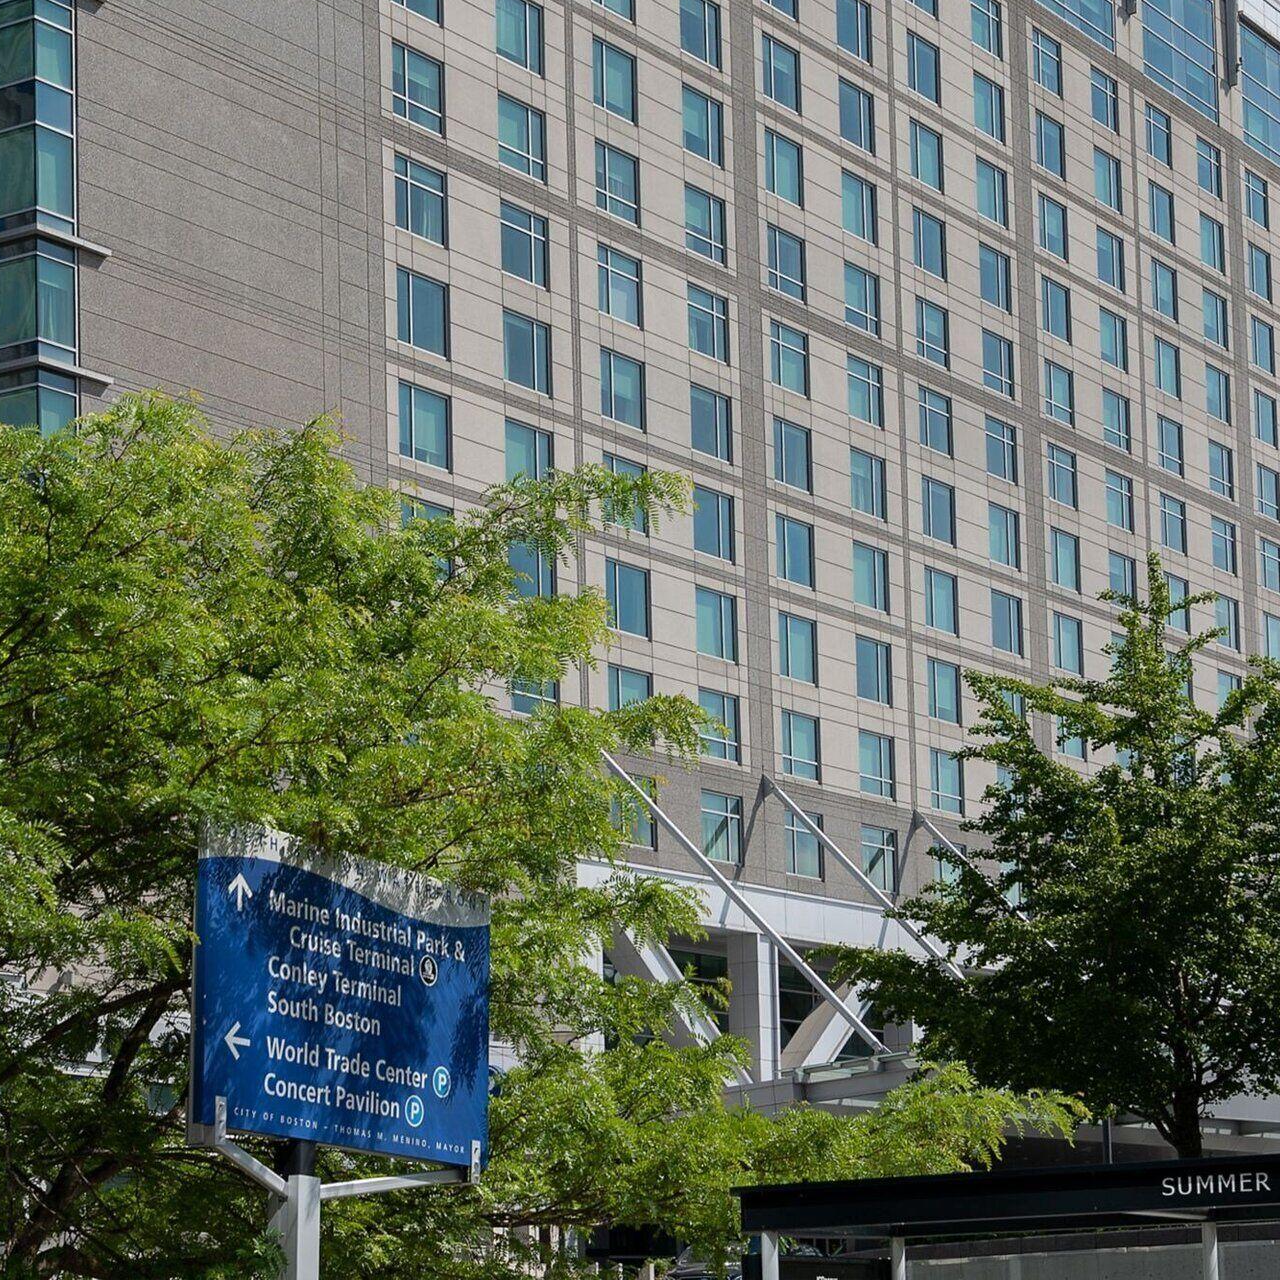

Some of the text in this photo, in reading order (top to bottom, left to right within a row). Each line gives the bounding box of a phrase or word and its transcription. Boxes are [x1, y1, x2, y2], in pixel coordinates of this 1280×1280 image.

[269, 889, 465, 962] Marine Industrial Park &
[290, 925, 414, 976] Cruise Terminal
[268, 956, 401, 1007] Conley Terminal
[268, 990, 380, 1036] South Boston
[267, 1036, 319, 1067] World
[324, 1047, 370, 1078] Trade
[376, 1060, 428, 1089] Center
[264, 1072, 331, 1106] Concert
[336, 1085, 400, 1119] Pavilion
[233, 1106, 257, 1119] CITY
[263, 1112, 274, 1121] OF
[280, 1114, 318, 1130] BOSTON
[334, 1124, 371, 1138] THOMAS
[377, 1132, 387, 1141] M.
[436, 1141, 465, 1154] MAYOR
[1161, 1171, 1271, 1197] SUMMER
